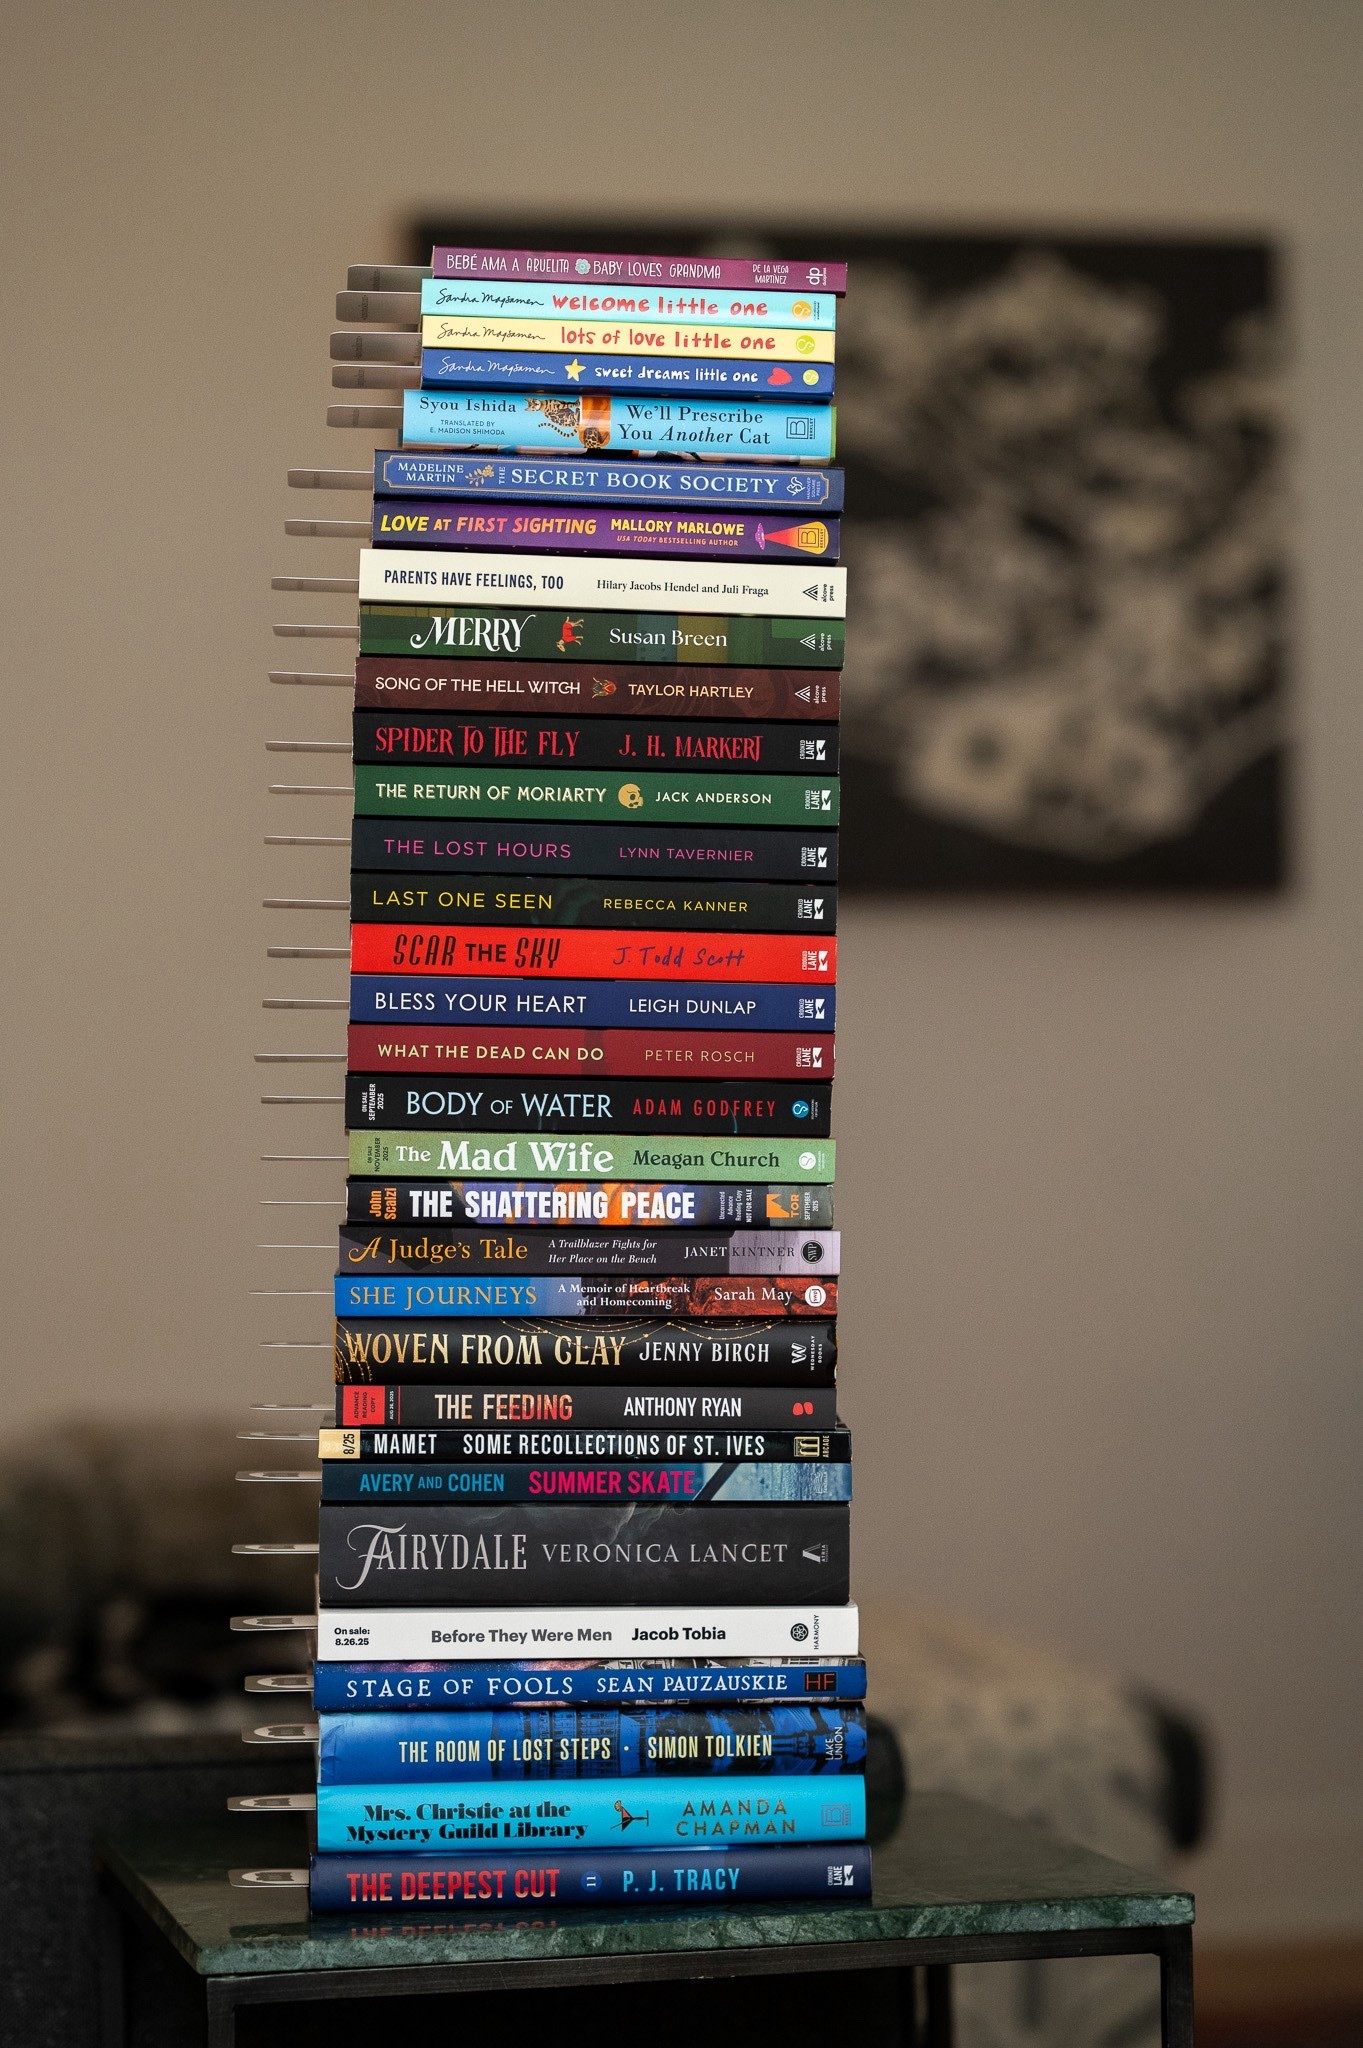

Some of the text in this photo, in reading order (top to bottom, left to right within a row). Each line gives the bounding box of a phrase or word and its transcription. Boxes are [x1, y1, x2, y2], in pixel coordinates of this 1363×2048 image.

[447, 254, 569, 273] BEBÉ AMA ABUELITA
[594, 261, 720, 279] BABY LOVES GRANDMA
[553, 295, 768, 315] welcome little one
[595, 366, 758, 382] sweet dreams little one
[420, 397, 516, 413] Syou Ishida
[678, 406, 763, 423] Prescribe
[618, 424, 770, 444] You Another Cat
[398, 463, 464, 473] MADELINE
[406, 473, 455, 482] MARTIN
[512, 469, 779, 493] SECRET BOOK SOCIETY
[611, 519, 744, 535] MALLORY MARLOWE
[385, 570, 564, 591] PARENTS HAVE FEELINGS, TOO
[597, 580, 769, 596] Hilary Jacobs Hendel and Juli Fraga
[410, 615, 536, 652] MERRY
[610, 628, 727, 647] Susan Breen
[375, 677, 580, 694] SONG OF THE HELL WITCH
[629, 684, 754, 698] TAYLOR HARTLEY
[806, 740, 815, 759] LANE
[656, 791, 771, 804] JACK ANDERSON
[603, 899, 748, 912] REBECCA KANNER
[376, 992, 586, 1013] BLESS YOUR HEART
[407, 1091, 612, 1118] BODY OF WATER
[396, 1141, 614, 1172] The Mad Wife
[633, 1150, 780, 1169] Meagan Church
[369, 1191, 382, 1217] John
[384, 1188, 396, 1219] Scalzi
[409, 1191, 695, 1219] THE SHATTERING PEACE
[791, 1194, 799, 1217] TOR
[480, 1237, 528, 1259] Tale
[558, 1239, 657, 1250] Trailblazer Fights for
[684, 1247, 794, 1259] JANET KINTNER
[350, 1286, 537, 1310] SHE JOURNEYS
[714, 1288, 793, 1305] Sarah May
[345, 1333, 626, 1366] WOVEN FROM CLAY
[639, 1342, 769, 1363] JENNY BIRCH
[435, 1394, 573, 1421] THE FEEDING
[624, 1397, 741, 1417] ANTHONY RYAN
[343, 1433, 355, 1455] 8/25
[374, 1433, 437, 1455] MAMET
[463, 1434, 765, 1456] SOME RECOLLECTIONS OF ST. IVES
[359, 1473, 504, 1492] AVERY AND COHEN
[529, 1471, 695, 1494] SUMMER SKATE
[336, 1523, 527, 1590] FAIRYDALE
[542, 1543, 788, 1563] VERONICA LANCET
[335, 1638, 369, 1646] 8.26.25
[431, 1628, 612, 1644] Before They Were Men
[632, 1627, 726, 1641] Jacob Tobia
[347, 1677, 573, 1698] STAGE OF FOOLS
[597, 1675, 788, 1693] SEAN PAUZAUSKIE
[399, 1738, 611, 1763] THE ROOM OF LOST STEPS
[648, 1734, 772, 1759] SIMON TOLKIEN
[364, 1801, 571, 1821] Mrs. Christie at the
[682, 1799, 787, 1816] AMANDA
[346, 1822, 588, 1845] Mystery Guild Library
[676, 1820, 796, 1836] CHAPMAN
[346, 1869, 560, 1902] THE DEEPEST CUT
[834, 1866, 842, 1885] LANE
